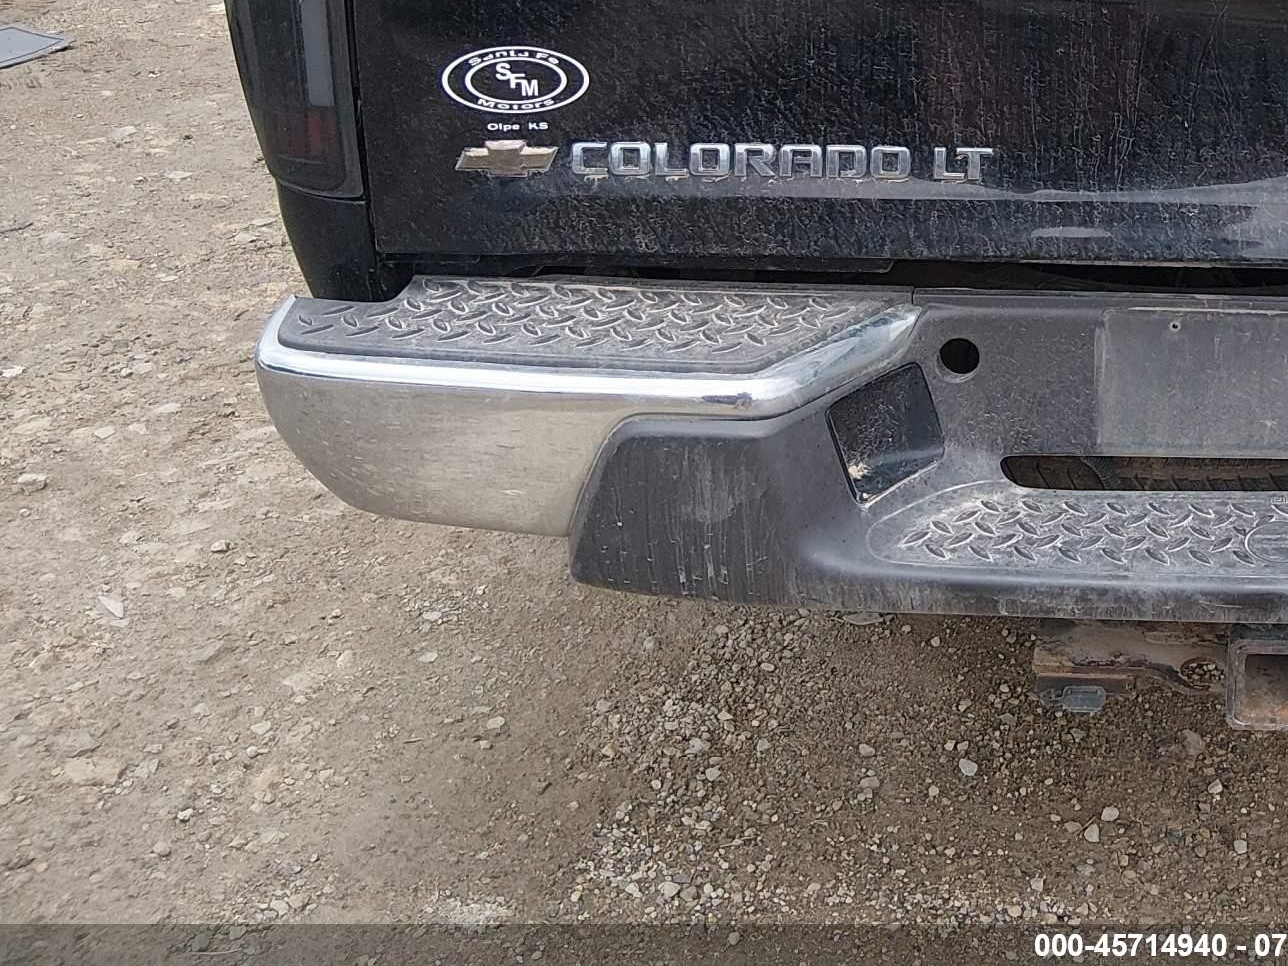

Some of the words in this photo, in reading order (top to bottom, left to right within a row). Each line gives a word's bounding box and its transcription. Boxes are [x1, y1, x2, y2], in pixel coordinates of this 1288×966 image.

[467, 49, 530, 67] Santa
[536, 51, 560, 65] Fe
[477, 98, 555, 110] Motors
[487, 122, 520, 132] Olpe
[528, 122, 549, 131] KS
[570, 140, 912, 179] COLORADO
[933, 145, 995, 180] LT
